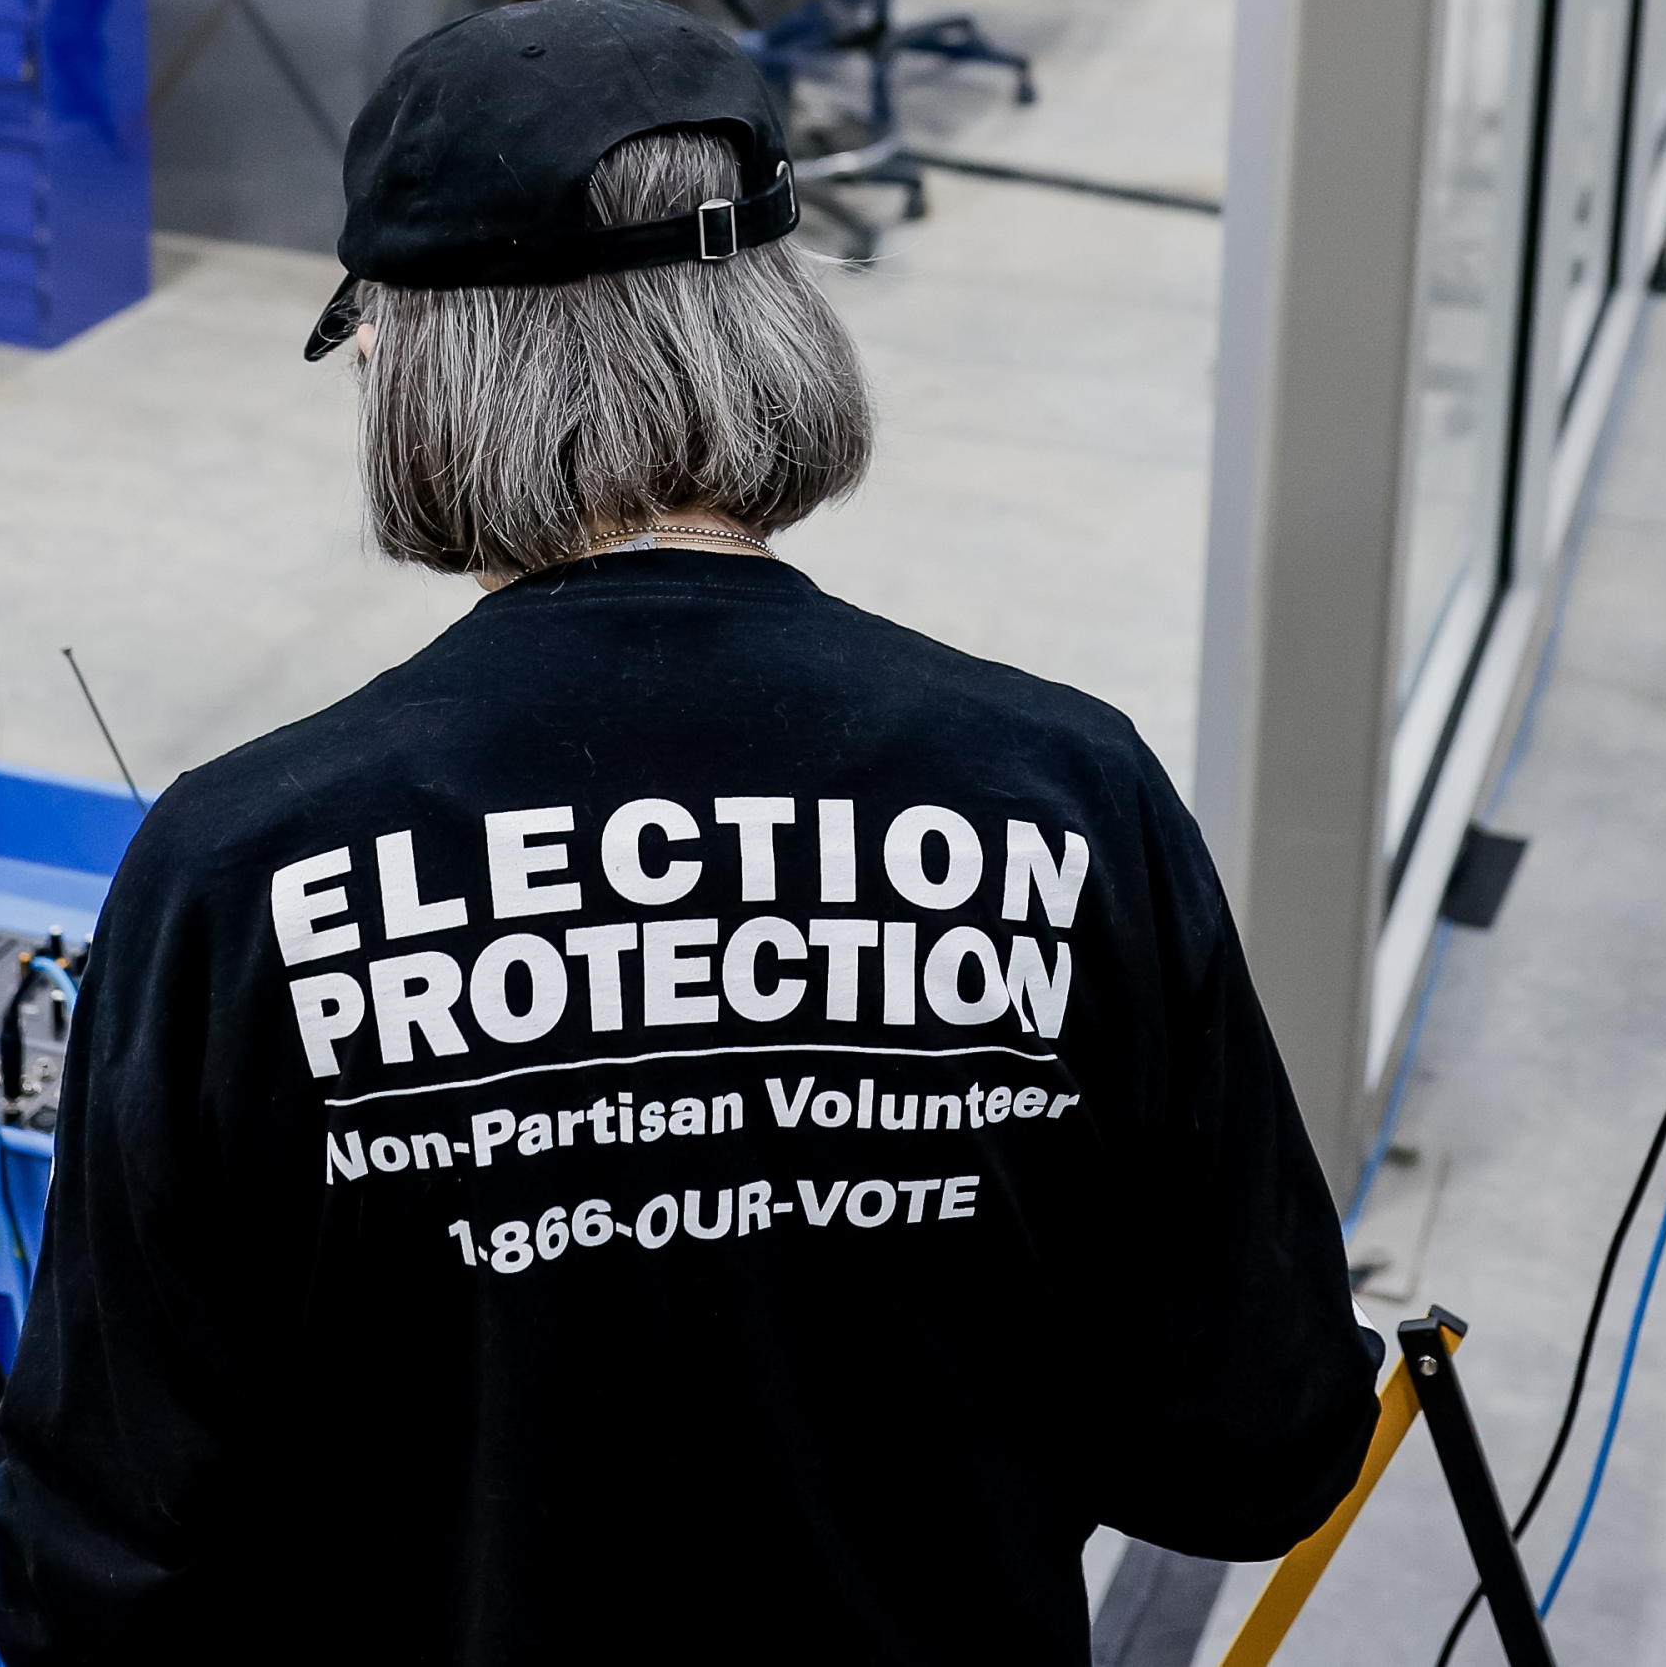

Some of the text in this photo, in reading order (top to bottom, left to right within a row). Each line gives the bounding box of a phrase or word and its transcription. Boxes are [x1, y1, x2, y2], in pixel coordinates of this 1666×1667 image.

[270, 796, 1090, 966] ELECTION
[288, 915, 1072, 1079] PROTECTION
[326, 1076, 1081, 1186] Non-Partisan Volunteer
[448, 1175, 981, 1274] 1-866-OUR-VOTE
